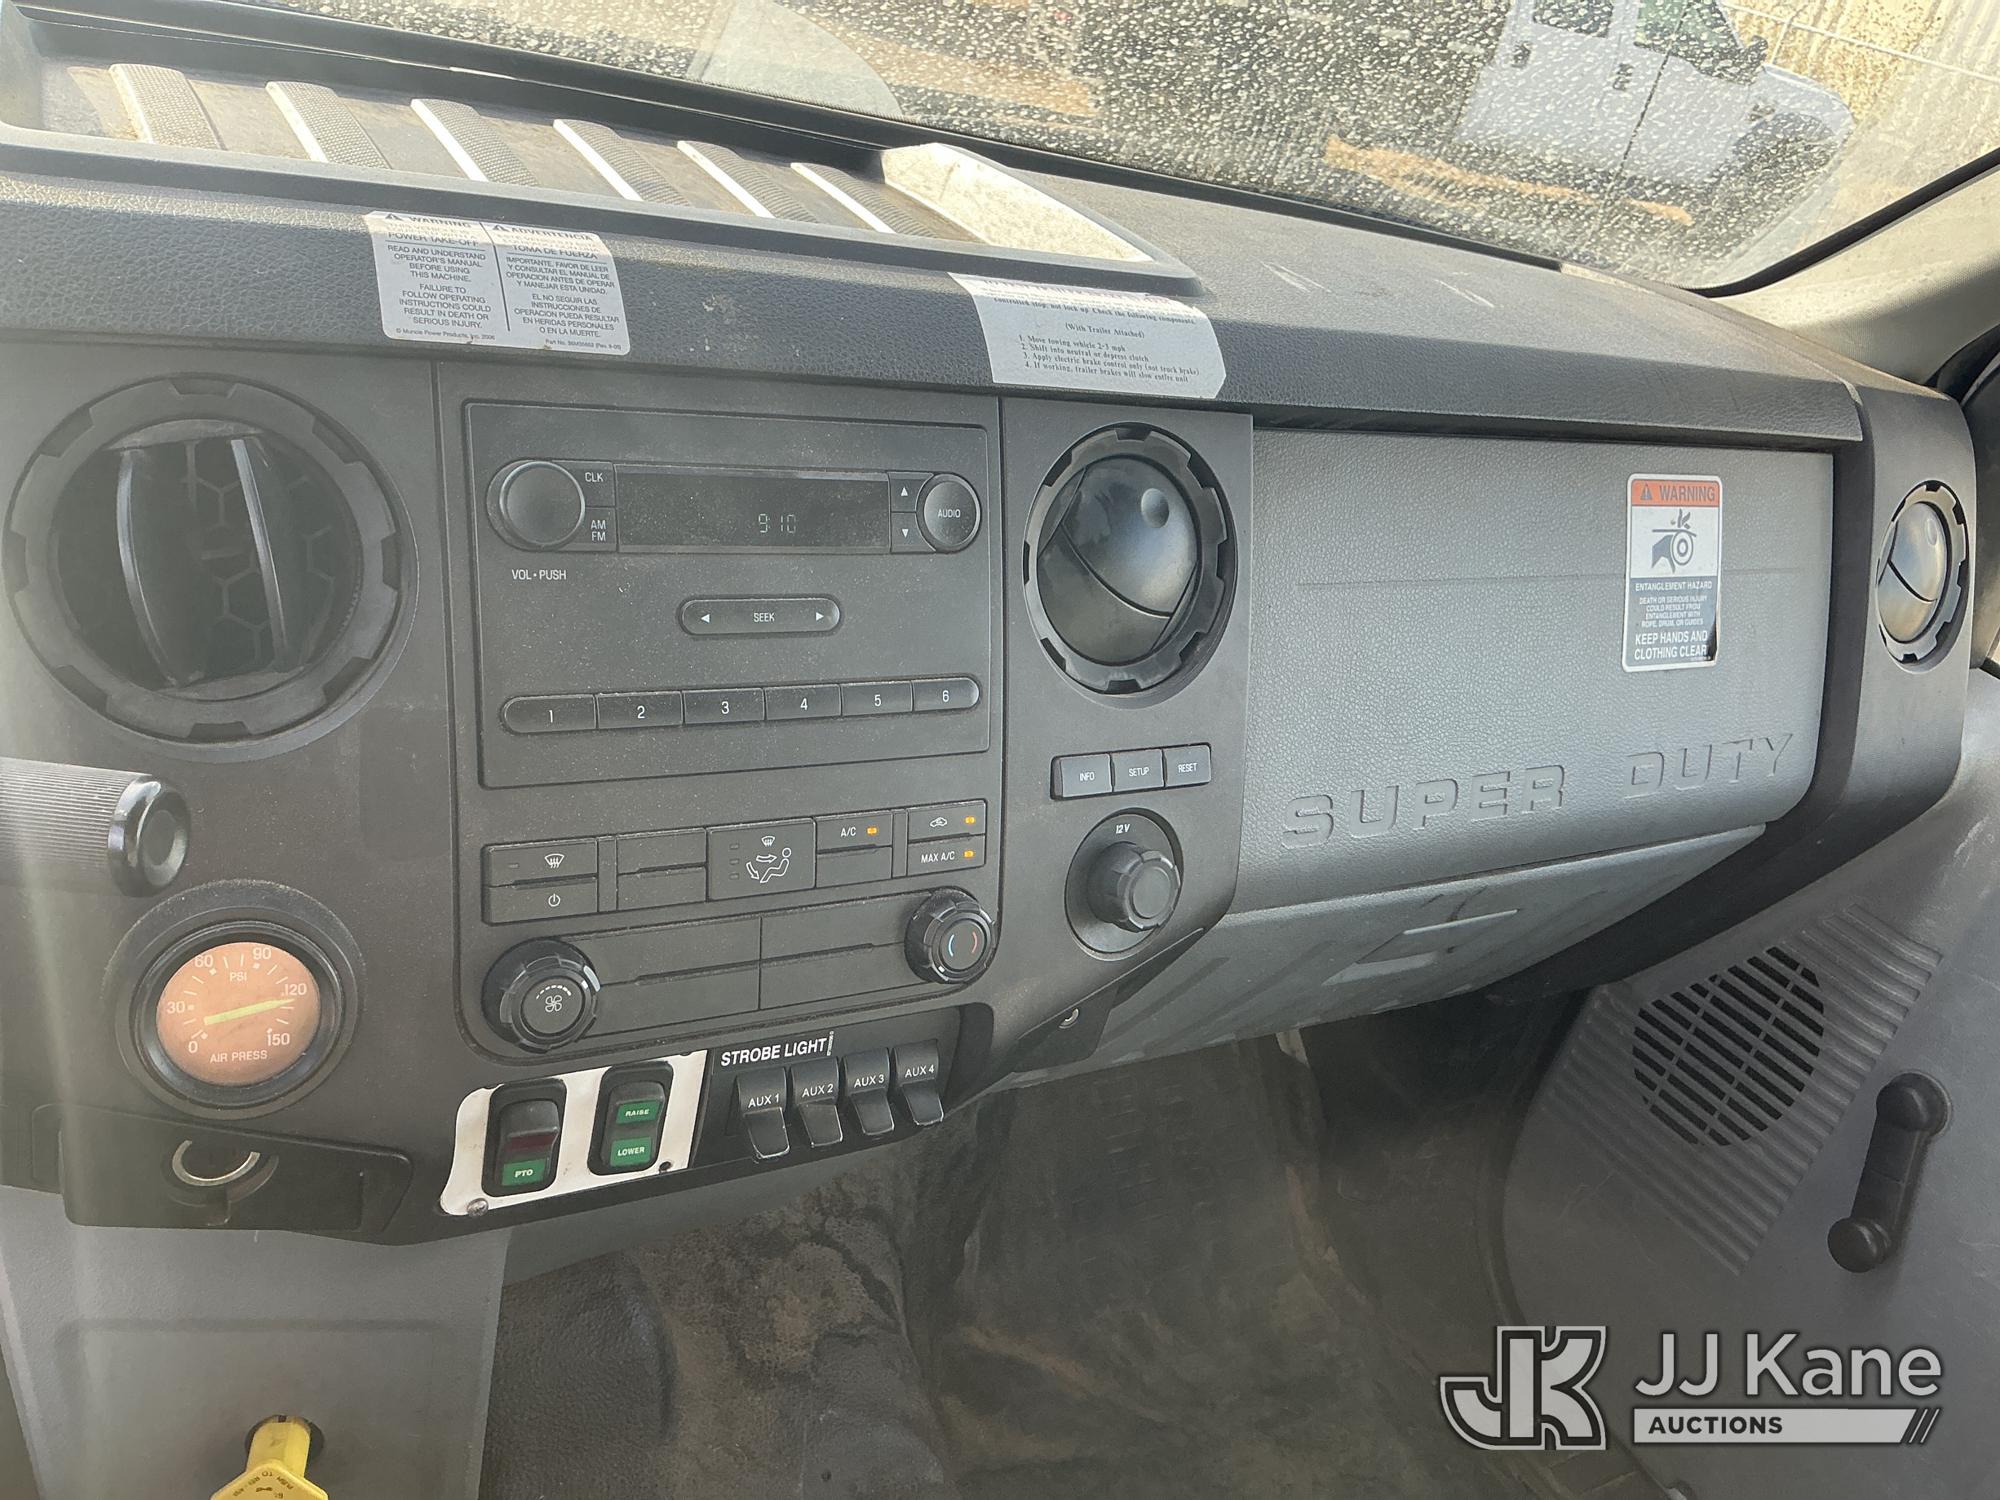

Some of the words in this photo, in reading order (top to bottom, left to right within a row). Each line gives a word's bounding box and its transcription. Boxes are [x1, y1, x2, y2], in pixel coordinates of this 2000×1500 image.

[388, 232, 425, 242] POWER
[431, 236, 479, 247] TAKE-OFF
[387, 244, 410, 253] READ
[412, 247, 430, 255] AND
[431, 249, 486, 260] UNDERSTAND
[513, 245, 543, 254] TOMA
[560, 249, 598, 259] FUERZA
[394, 253, 446, 263] OPERATOR'S
[447, 259, 483, 267] MANUAL
[409, 263, 441, 272] BEFORE
[444, 266, 470, 275] USING
[515, 265, 558, 275] CONSULTAR
[569, 270, 599, 279] MANUAL
[556, 262, 580, 270] FAVOR
[591, 265, 609, 273] LEER
[410, 270, 430, 279] THIS
[432, 272, 471, 282] MACHINE.
[506, 272, 549, 282] OPERACION
[551, 276, 574, 284] ANTES
[587, 279, 615, 288] OPERAR
[419, 283, 453, 293] FAILURE
[455, 286, 467, 294] TO
[523, 281, 559, 291] MANEJAR
[560, 285, 578, 293] ESTA
[578, 286, 608, 295] UNIDAD.
[402, 290, 437, 299] FOLLOW
[439, 293, 486, 304] OPERATING
[532, 293, 542, 301] EL
[555, 296, 583, 304] SEGUIR
[584, 298, 598, 306] LAS
[399, 299, 460, 310] INSTRUCTIONS
[462, 304, 491, 313] COULD
[531, 301, 590, 312] INSTRUCCIONES
[591, 306, 602, 314] DE
[404, 307, 435, 316] RESULT
[447, 311, 475, 319] DEATH
[476, 313, 490, 321] OR
[514, 308, 558, 318] OPERACION
[559, 312, 584, 320] PUEDA
[585, 314, 620, 324] RESULTAR
[412, 317, 450, 326] SERIOUS
[451, 320, 483, 329] INJURY.
[534, 318, 566, 327] HERIDAS
[567, 321, 615, 331] PERSONALES
[1065, 322, 1086, 332] (With
[1087, 326, 1111, 335] Trailer
[1113, 328, 1145, 338] Attached)
[1027, 335, 1046, 343] Move
[1048, 338, 1071, 348] towing
[1072, 341, 1096, 349] vehicle
[1097, 342, 1109, 350] 2-3
[1111, 345, 1126, 353] mph
[1029, 342, 1048, 352] Shift
[1050, 346, 1065, 354] into
[1066, 349, 1092, 357] neutral
[1103, 351, 1128, 361] depress
[1129, 354, 1149, 362] clutch
[1033, 352, 1052, 361] Apply
[1054, 355, 1080, 364] electric
[1082, 358, 1101, 366] brake
[1103, 361, 1127, 369] control
[1129, 363, 1143, 371] only
[1144, 363, 1159, 372] (not
[1160, 365, 1178, 374] truck
[1034, 361, 1041, 369] If
[1075, 366, 1098, 375] trailer
[1099, 367, 1122, 377] brakes
[1123, 370, 1137, 378] will
[1154, 374, 1174, 382] entire
[584, 471, 605, 483] CLK
[1659, 484, 1716, 502] WARNING
[937, 508, 962, 519] AUDIO
[590, 520, 607, 530] AM
[591, 532, 607, 542] FM
[511, 569, 532, 581] VOL
[538, 569, 567, 581] PUSH
[1635, 581, 1686, 592] ENTANGLEMENT
[1687, 580, 1713, 590] HAZARD
[753, 612, 775, 623] SEEK
[1635, 632, 1658, 645] KEEP
[1660, 631, 1689, 644] HANDS
[1690, 630, 1708, 642] AND
[1634, 646, 1678, 660] CLOTHING
[1679, 644, 1707, 658] CLEAR
[548, 710, 554, 724] 1
[637, 706, 646, 719] 2
[721, 701, 730, 715] 3
[800, 697, 809, 711] 4
[873, 694, 882, 708] 5
[941, 690, 950, 703] 6
[1079, 771, 1095, 783] INFO
[1128, 766, 1150, 778] SETUP
[1178, 762, 1198, 774] RESET
[1281, 764, 1565, 851] SUPER
[1623, 732, 1794, 799] DUTY
[840, 826, 857, 838] A/C
[920, 852, 939, 864] MAX
[940, 851, 956, 862] A/C
[194, 953, 214, 969] 60
[253, 947, 272, 962] 90
[229, 971, 248, 983] PSI
[284, 983, 308, 997] 120
[166, 1001, 186, 1014] 30
[267, 1033, 291, 1046] 150
[188, 1041, 198, 1054] 0
[720, 1044, 781, 1068] STROBE
[783, 1038, 828, 1059] LIGHT
[209, 1052, 228, 1064] AIR
[232, 1050, 268, 1062] PRESS
[904, 1066, 927, 1079] AUX
[927, 1064, 935, 1075] 4
[853, 1076, 876, 1089] AUX
[877, 1074, 885, 1085] 3
[801, 1086, 824, 1099] AUX
[826, 1084, 834, 1095] 2
[748, 1095, 772, 1109] AUX
[774, 1093, 780, 1104] 1
[625, 1108, 650, 1118] RAISE
[617, 1146, 646, 1157] LOWER
[514, 1168, 534, 1179] PTO
